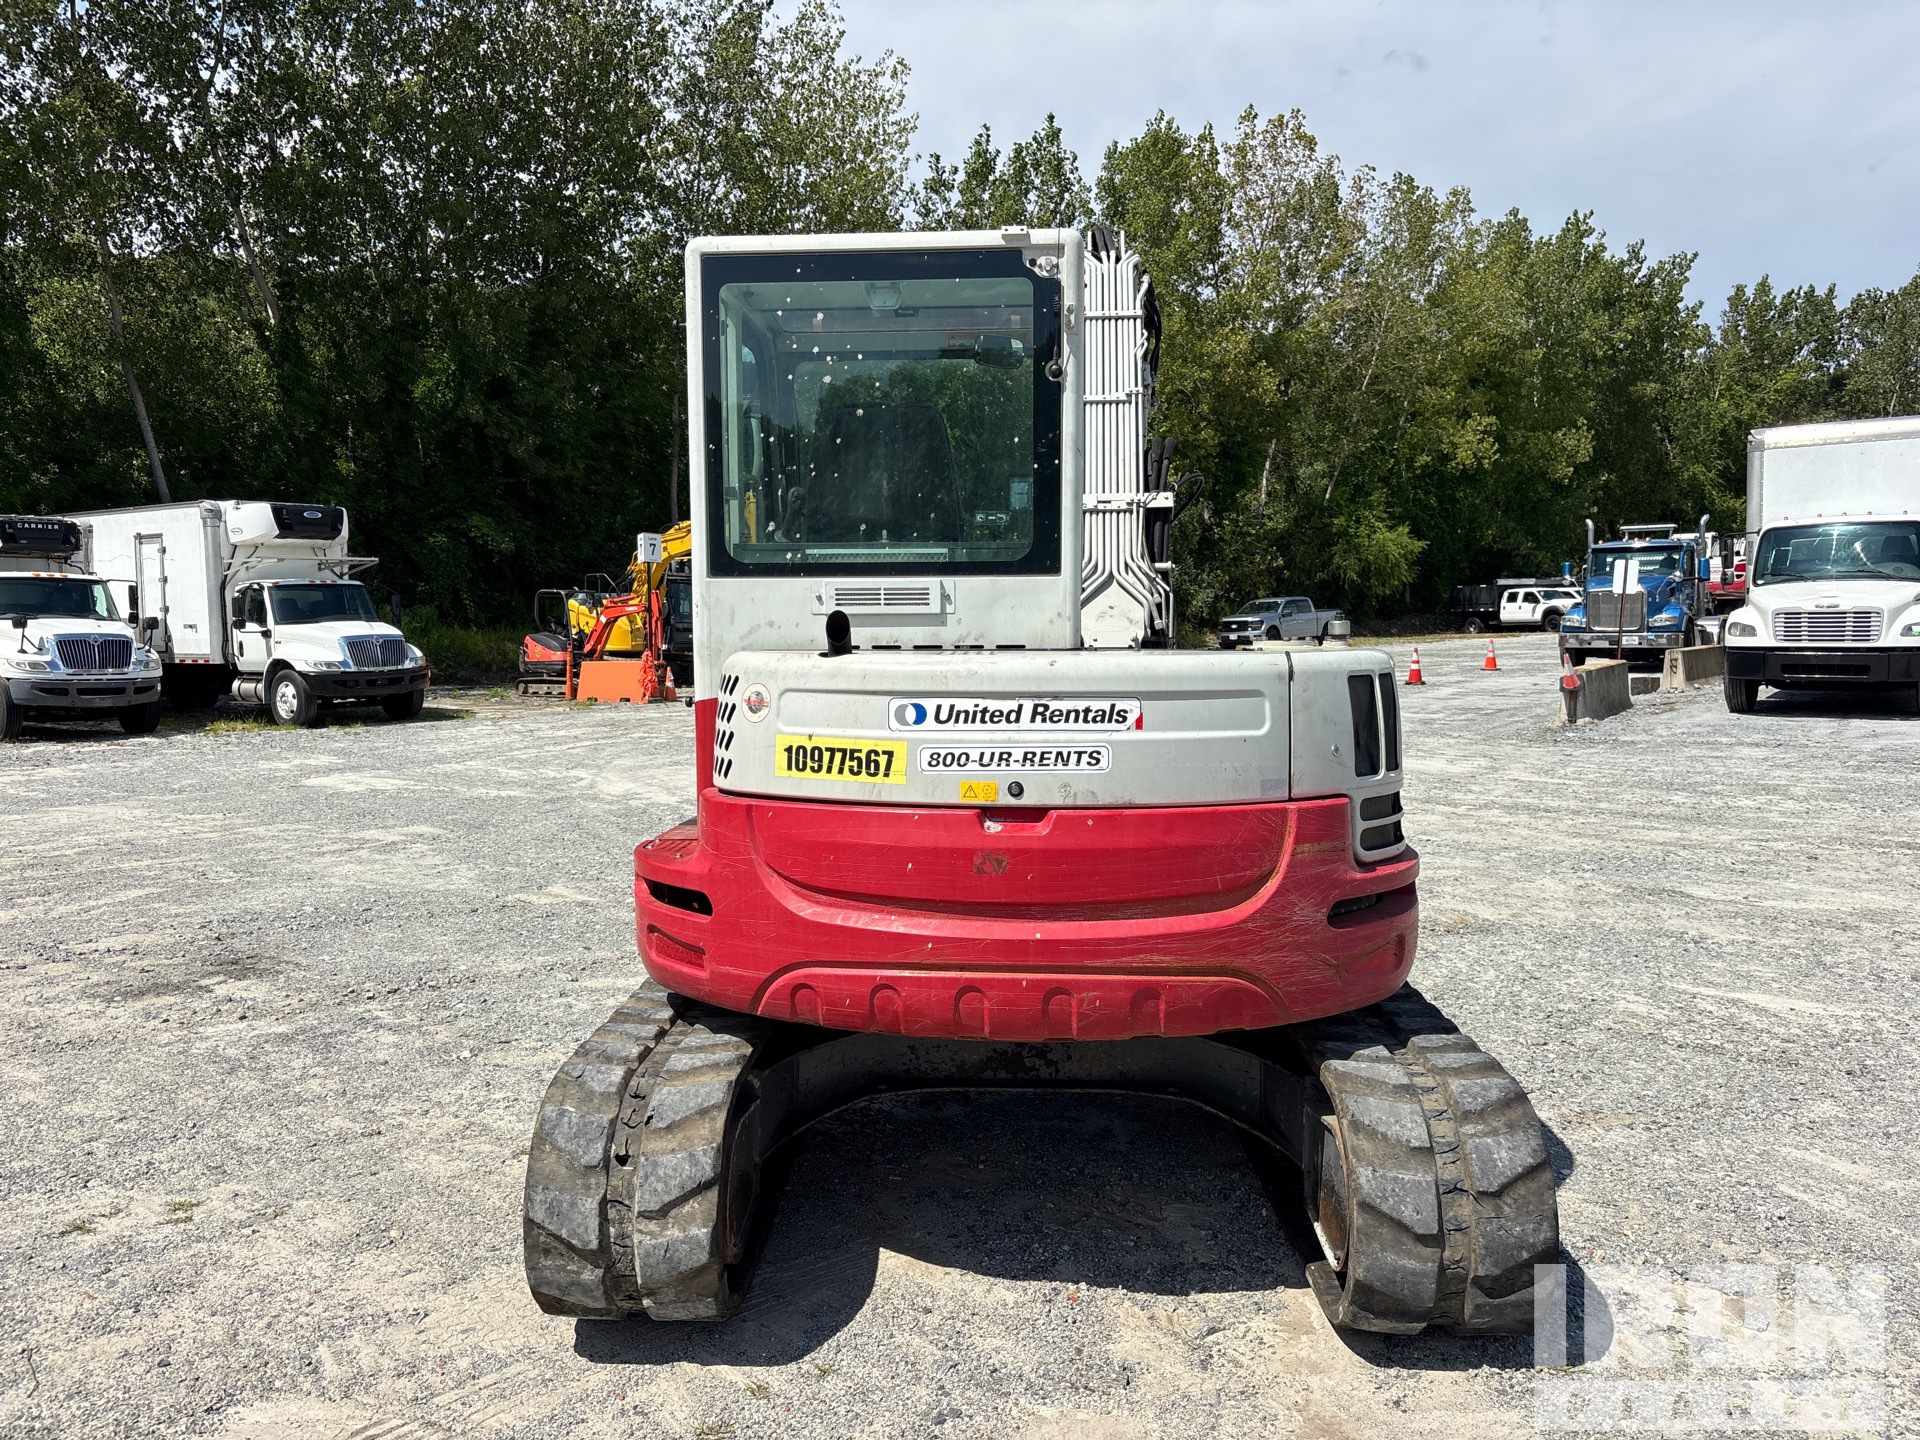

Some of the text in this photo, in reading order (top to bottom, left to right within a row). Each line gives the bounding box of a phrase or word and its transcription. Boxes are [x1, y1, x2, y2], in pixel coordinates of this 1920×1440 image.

[17, 522, 59, 530] CARRIER
[649, 542, 657, 556] 7
[934, 703, 1129, 725] United Rentals
[783, 744, 895, 778] 10977567
[927, 750, 1101, 767] 800-UR-RENTS
